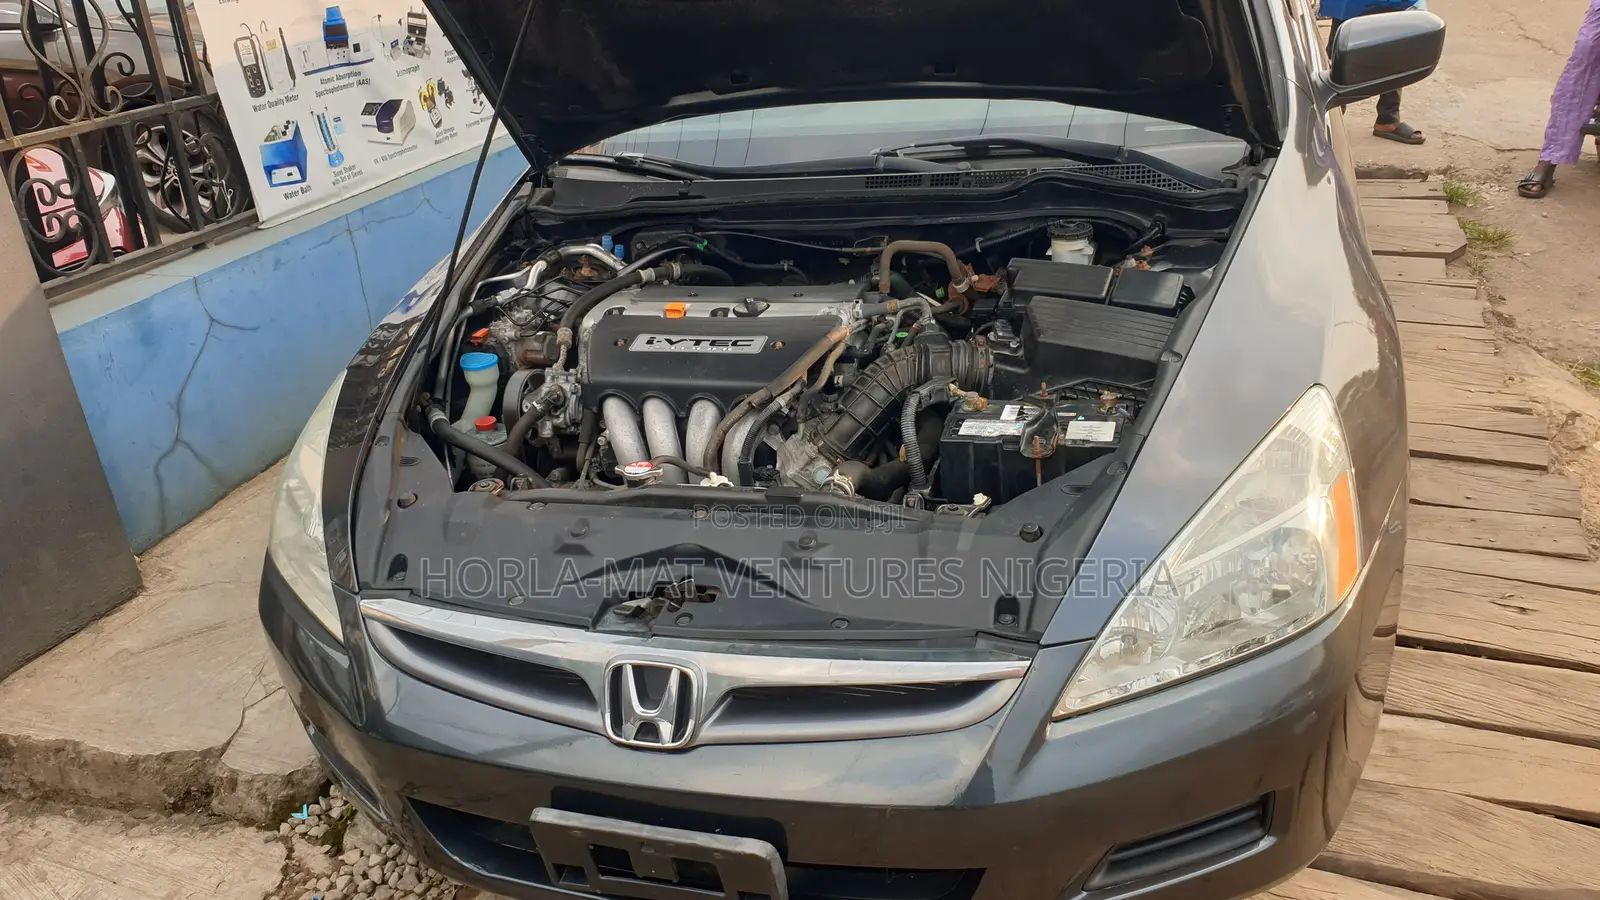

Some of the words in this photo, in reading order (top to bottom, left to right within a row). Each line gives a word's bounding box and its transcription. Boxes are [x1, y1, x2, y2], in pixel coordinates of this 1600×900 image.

[320, 76, 335, 85] Atomic
[335, 71, 361, 82] Absorption
[356, 78, 371, 87] (AAS)
[252, 102, 267, 113] Water
[267, 97, 285, 109] Quality
[284, 94, 300, 104] Meter
[283, 189, 300, 200] Water
[300, 185, 312, 195] Bath
